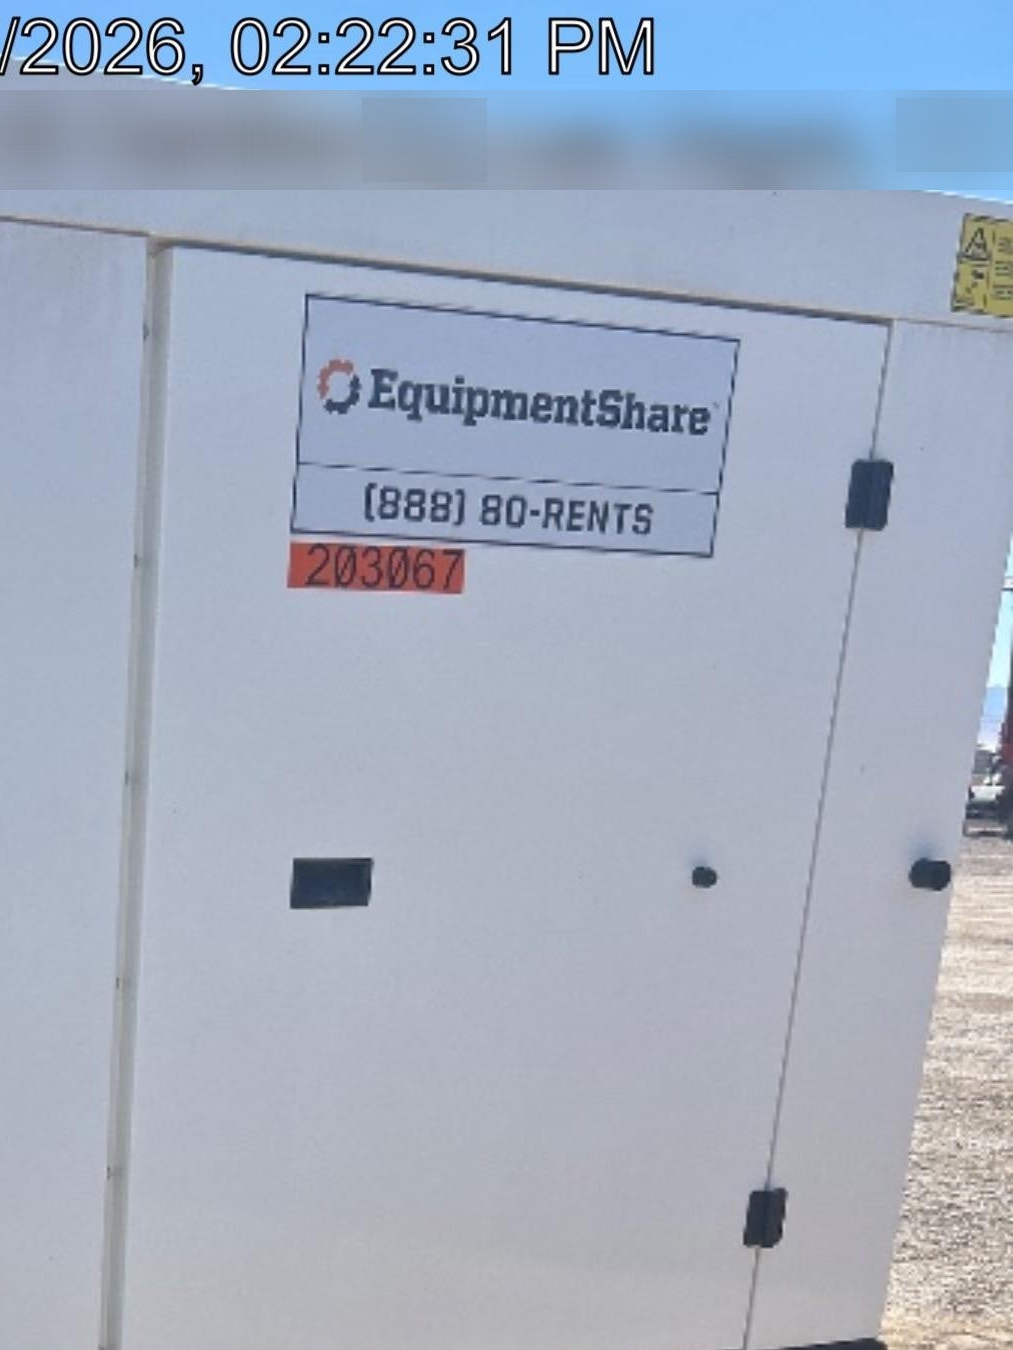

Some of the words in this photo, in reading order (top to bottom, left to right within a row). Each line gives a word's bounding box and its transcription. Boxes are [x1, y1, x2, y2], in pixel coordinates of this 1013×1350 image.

[367, 367, 712, 436] EquipmentShare
[363, 482, 466, 526] (888)
[479, 493, 655, 536] 80-RENTS
[304, 541, 465, 590] 203067
